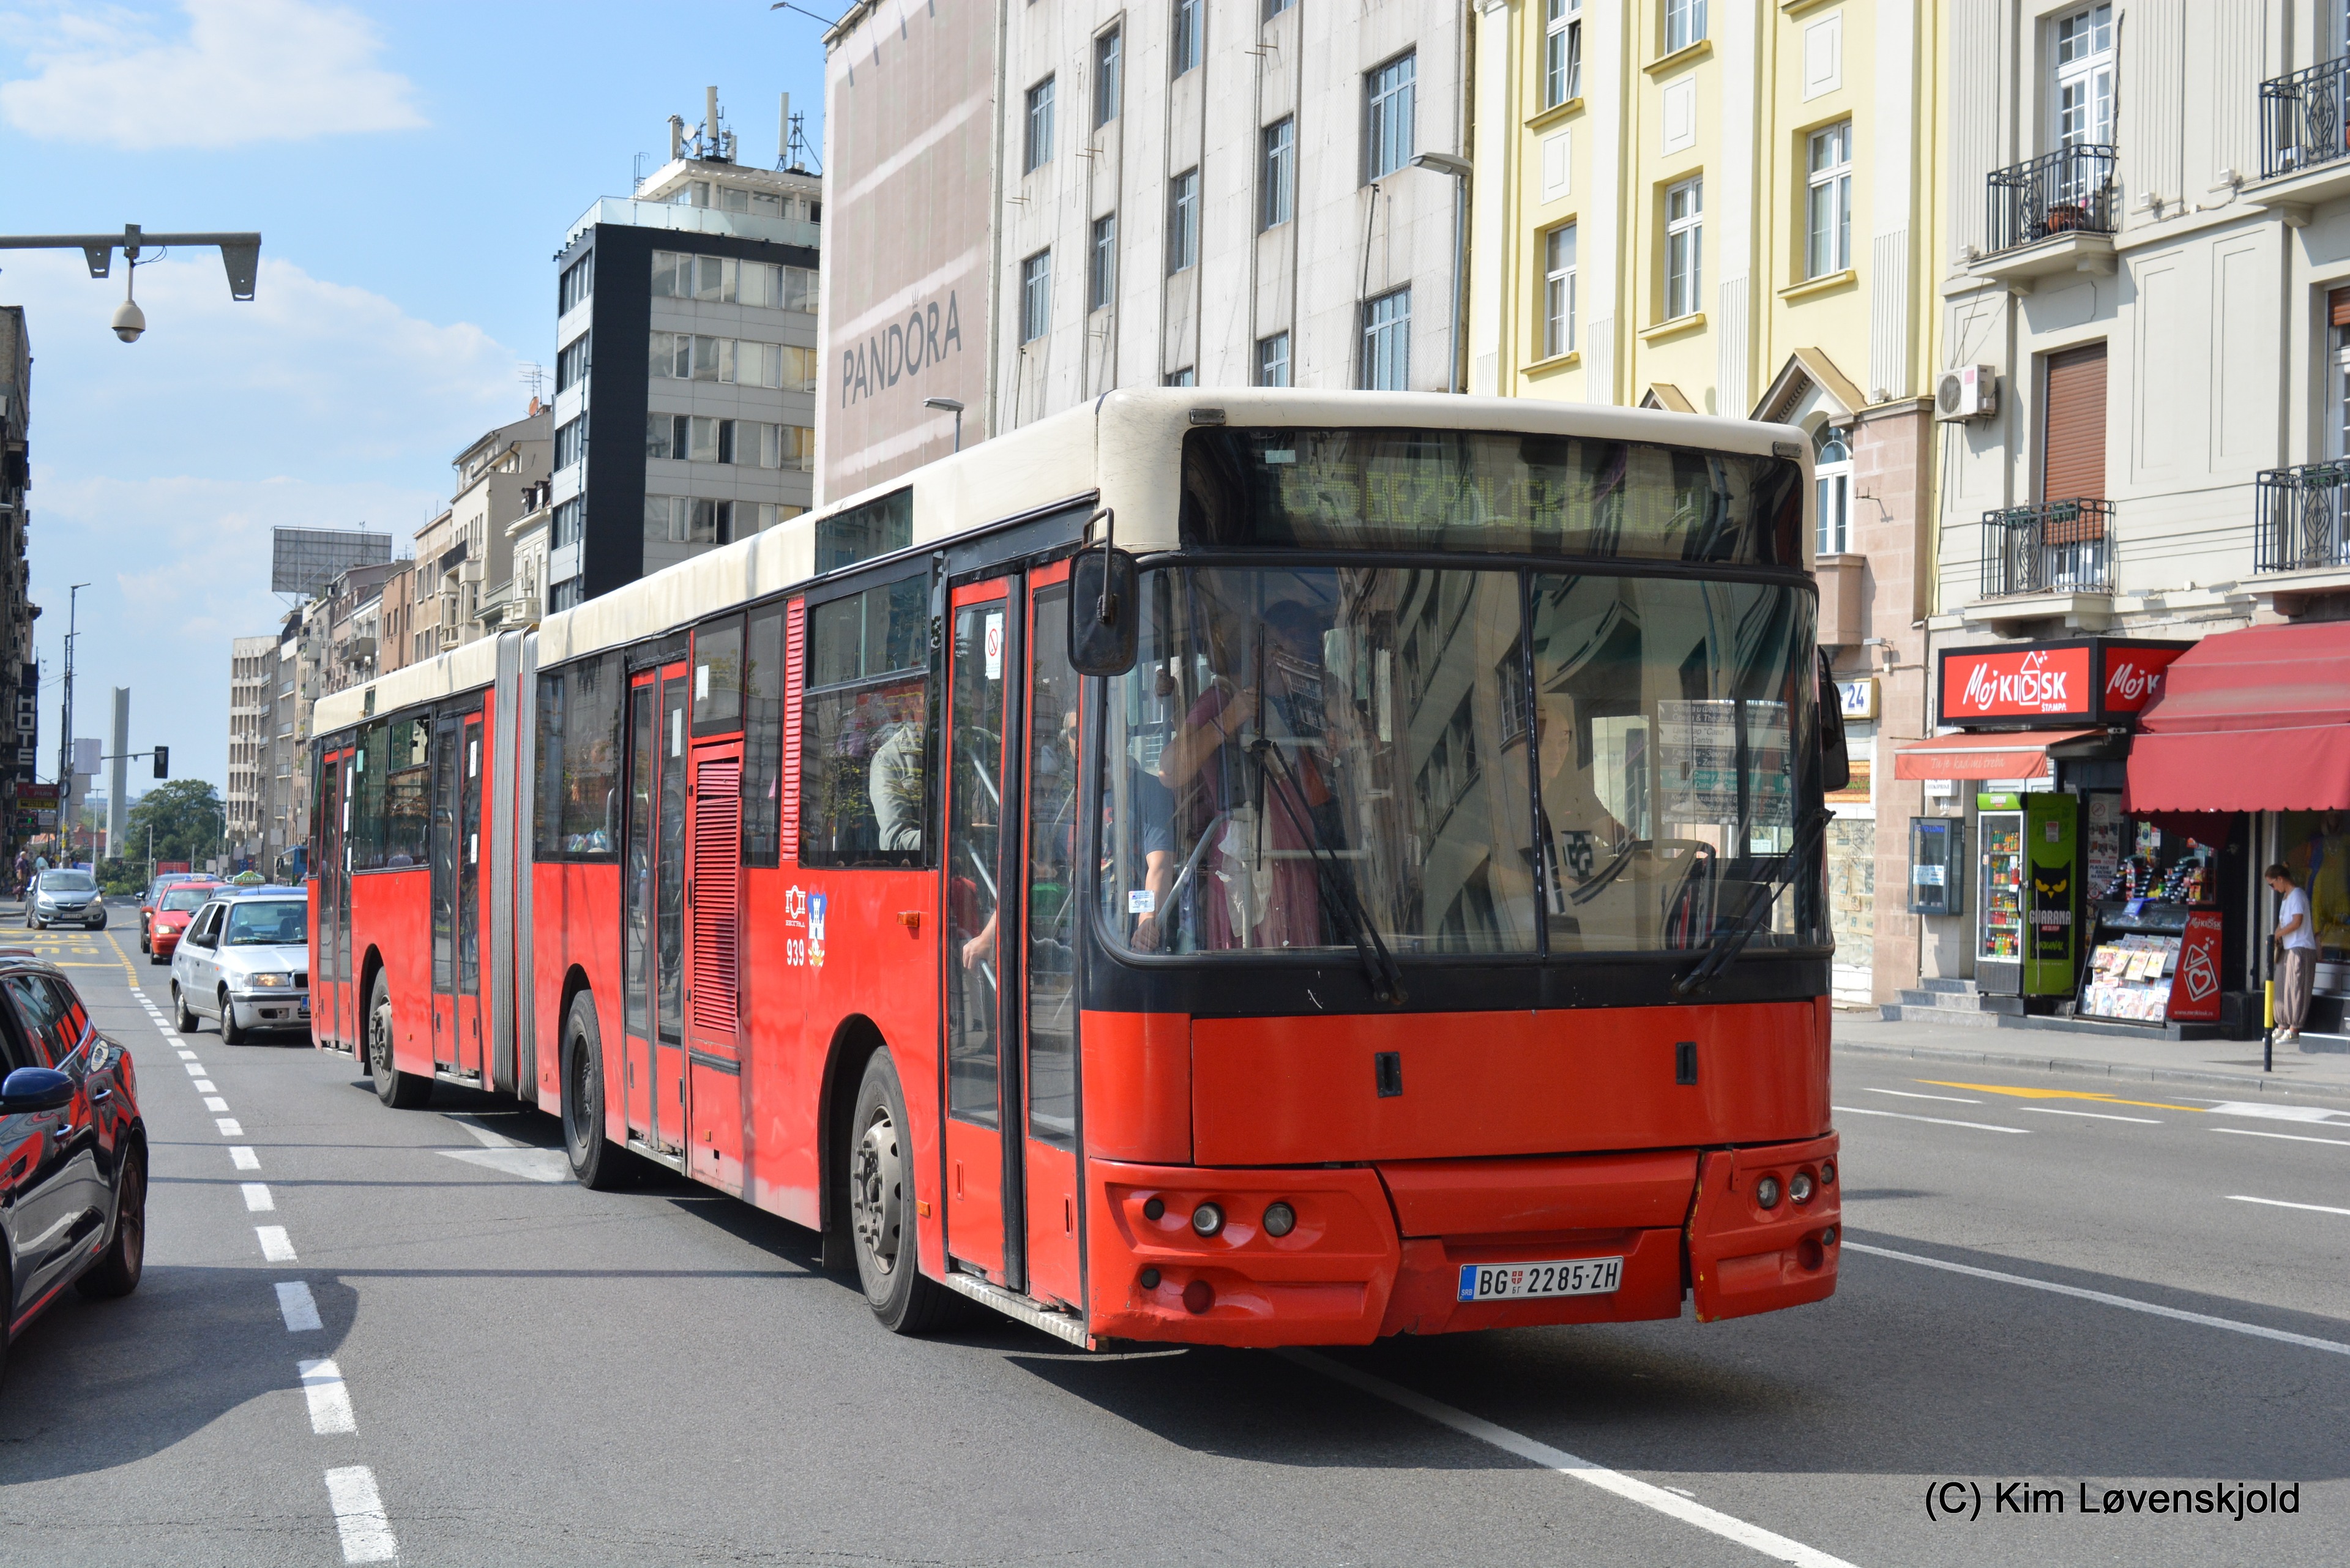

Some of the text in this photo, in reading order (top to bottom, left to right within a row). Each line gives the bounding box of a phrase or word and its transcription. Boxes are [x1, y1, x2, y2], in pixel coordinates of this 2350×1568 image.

[842, 289, 961, 409] PANDORA
[1280, 462, 1360, 515] 65
[1963, 662, 2067, 710] Moj KIOSK
[2106, 663, 2144, 700] Moj
[1848, 684, 1864, 708] 24
[2042, 702, 2067, 712] ŠTAMPA
[1704, 714, 1729, 723] Theatre
[17, 695, 36, 783] HOTEL
[1953, 753, 1971, 769] kad
[1983, 753, 2005, 769] treba
[2029, 909, 2071, 925] GUARANA
[787, 938, 805, 966] 939
[1479, 1269, 1508, 1296] BG
